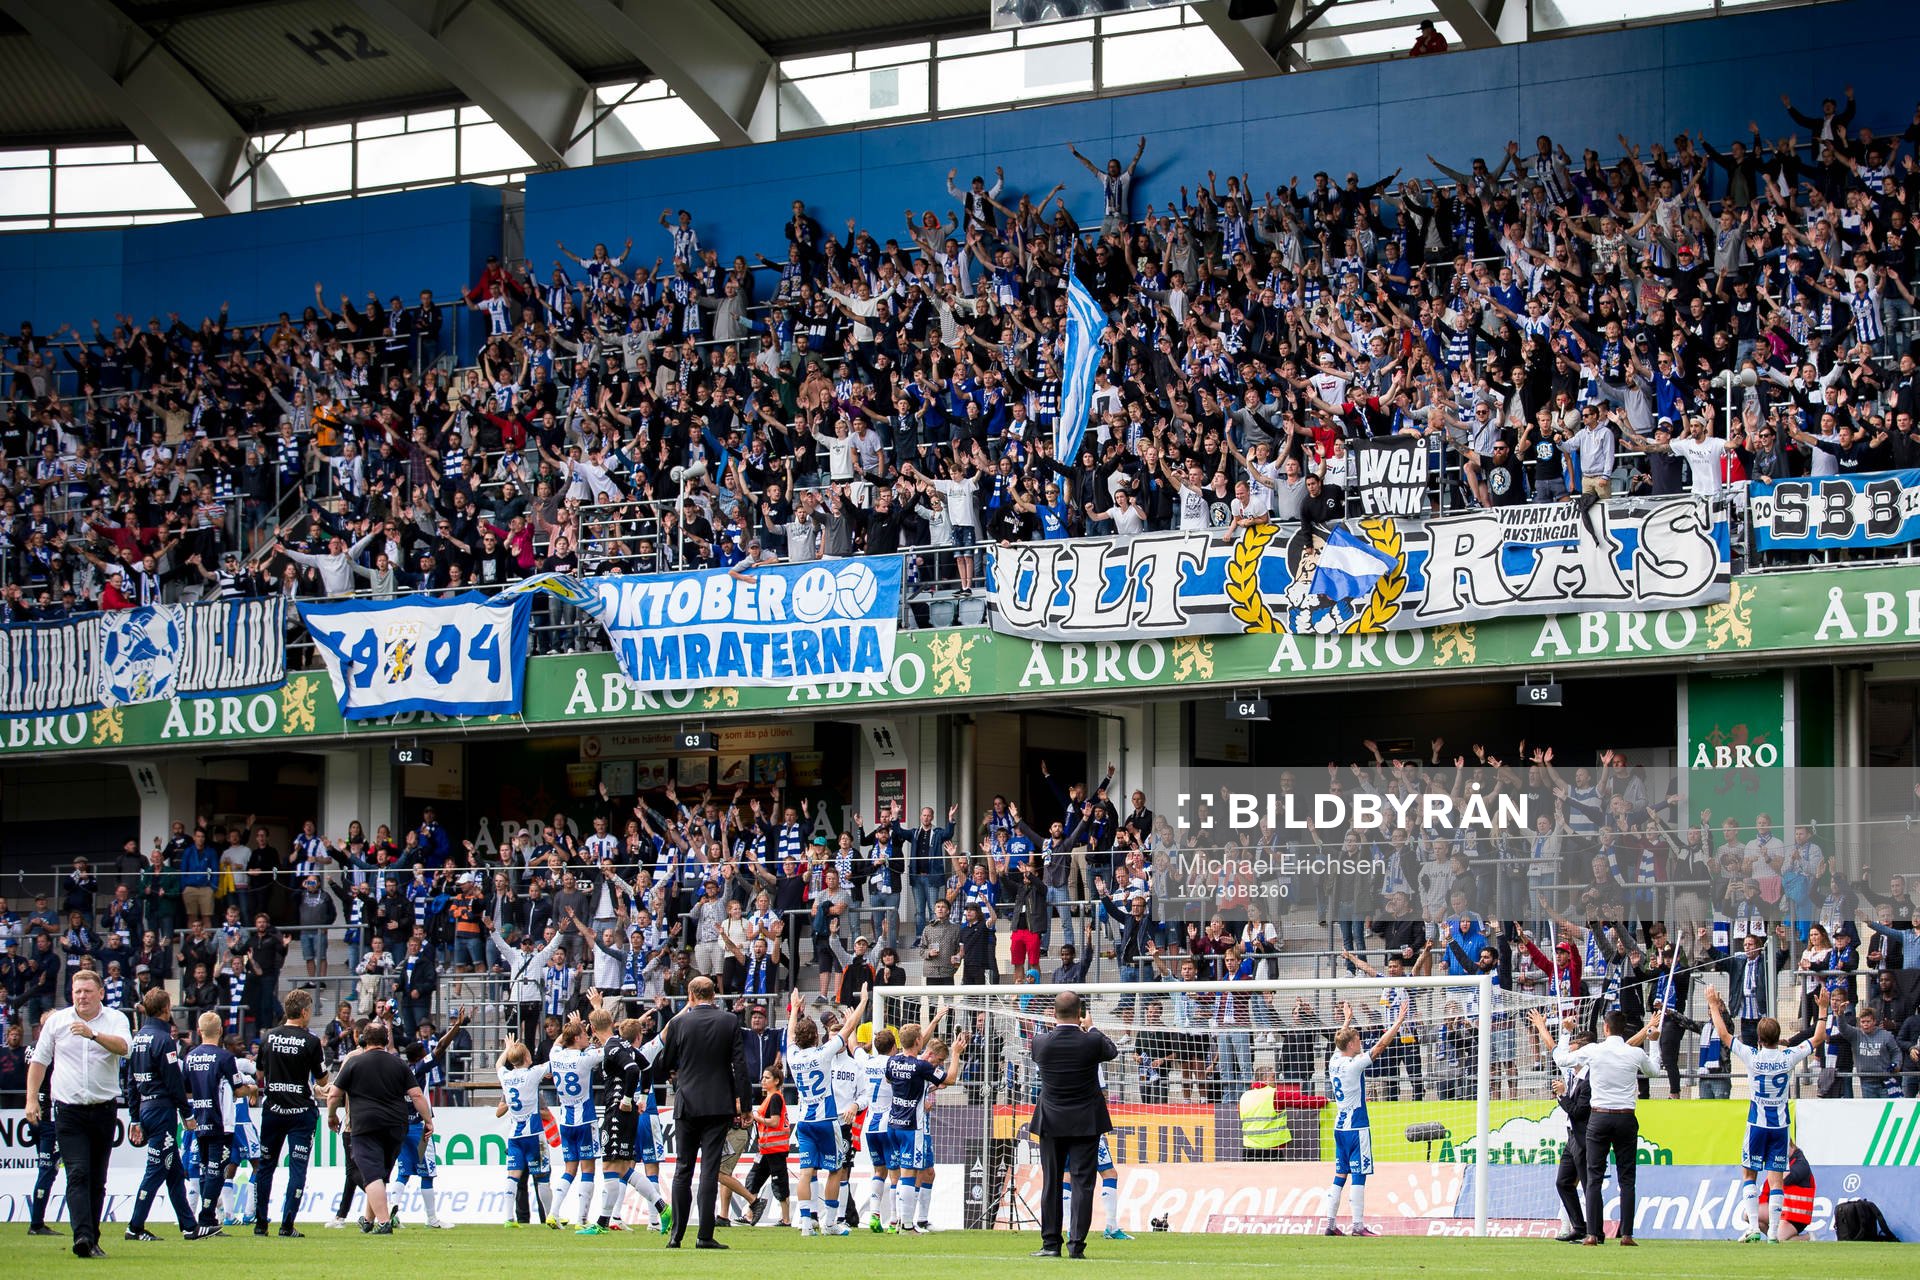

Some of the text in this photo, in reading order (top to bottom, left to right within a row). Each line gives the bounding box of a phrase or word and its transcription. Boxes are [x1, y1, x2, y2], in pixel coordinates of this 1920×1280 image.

[285, 24, 391, 66] H2
[1360, 438, 1427, 487] AVGÅ
[1360, 486, 1425, 515] FRNK
[1755, 501, 1772, 521] 20
[1770, 479, 1904, 540] SBB
[1497, 506, 1552, 525] YMPATI
[995, 535, 1209, 632] ULT
[615, 625, 884, 682] AMRATERNA
[1019, 638, 1166, 688] ÅBRO
[1530, 688, 1548, 700] G5
[160, 693, 278, 739] ÅBRO
[1239, 703, 1256, 716] G4
[0, 712, 88, 749] BRO
[685, 735, 700, 747] G3
[398, 751, 413, 762] G2
[1691, 742, 1778, 770] ÅBRO
[268, 1033, 306, 1048] Prioritet
[272, 1043, 299, 1055] Finans
[1755, 1061, 1788, 1071] SERNEKE
[268, 1083, 304, 1094] SERNEKE
[552, 1071, 582, 1096] 28
[869, 1077, 883, 1103] 7
[1332, 1076, 1345, 1102] 8
[1753, 1072, 1789, 1099] 19
[508, 1087, 523, 1112] 3
[294, 1144, 309, 1153] NRC
[1222, 1215, 1314, 1235] Prioritet
[1427, 1220, 1524, 1237] Prioitet
